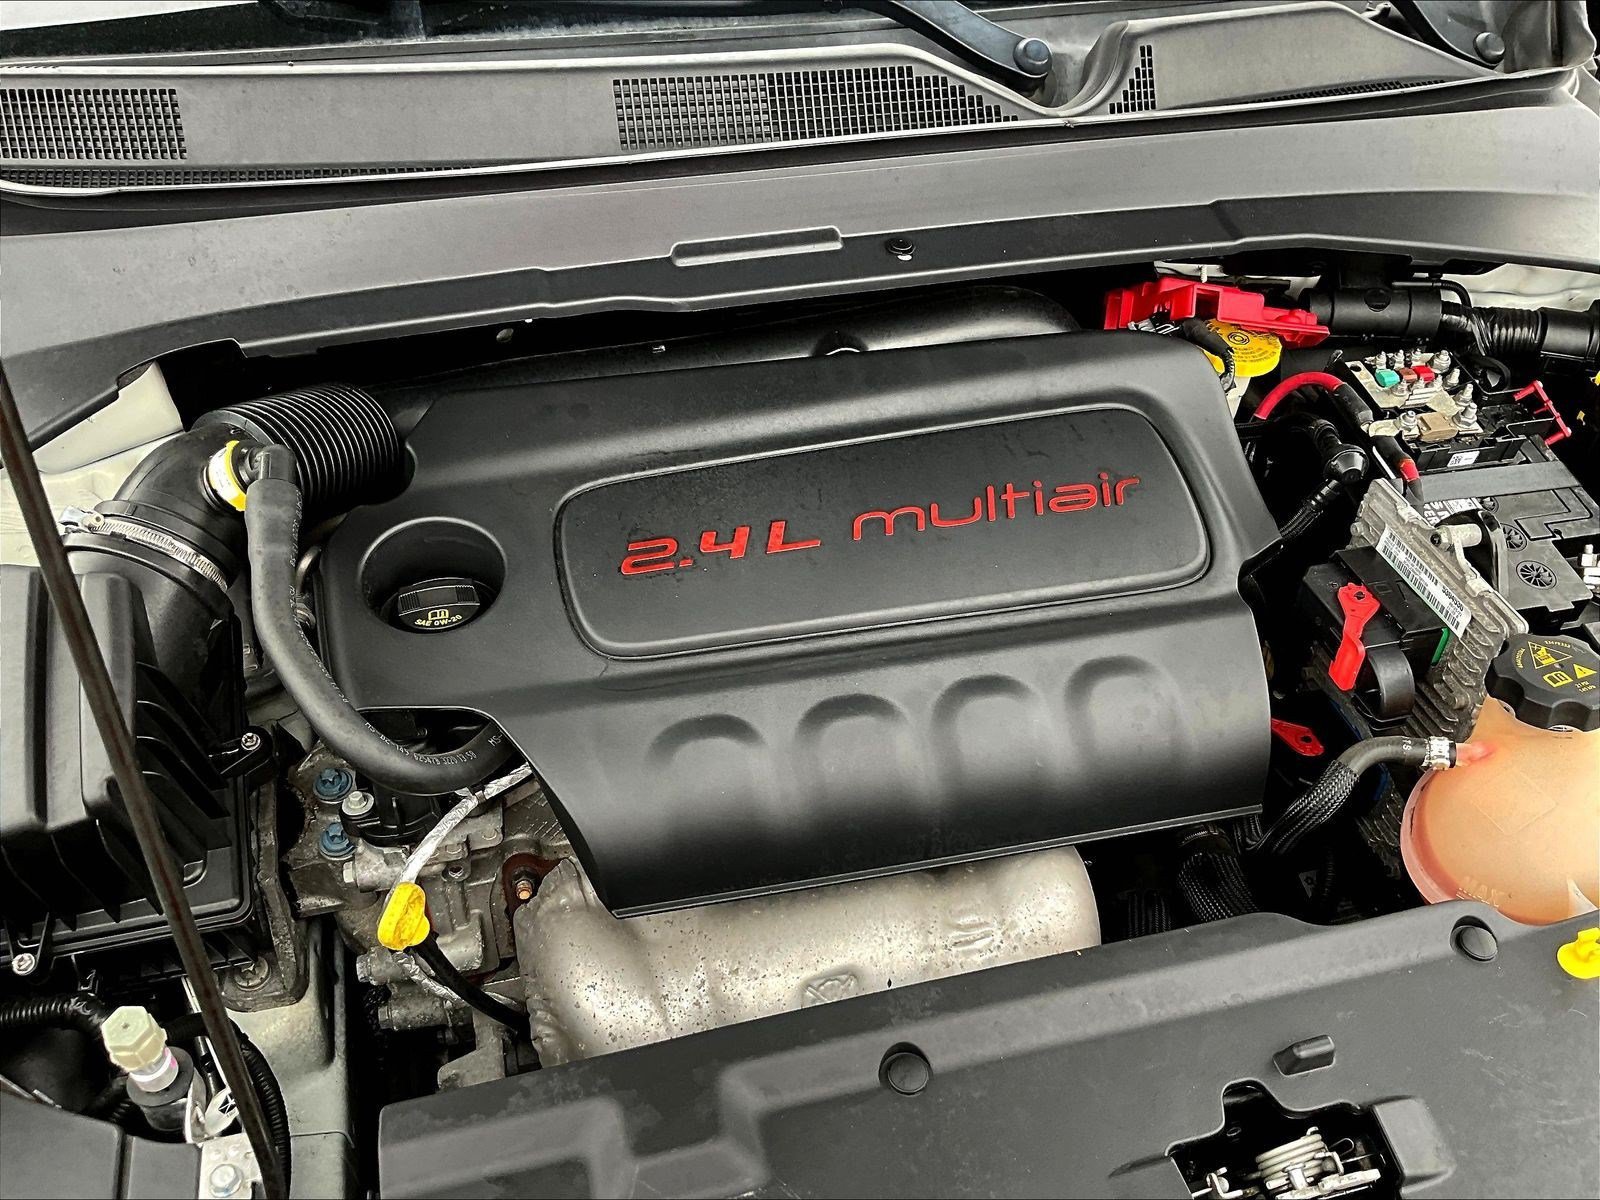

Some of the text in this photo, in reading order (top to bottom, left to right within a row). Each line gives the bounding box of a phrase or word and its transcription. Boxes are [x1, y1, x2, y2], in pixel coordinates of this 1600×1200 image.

[853, 472, 1140, 541] multiair
[414, 614, 462, 627] SAE 0W-20
